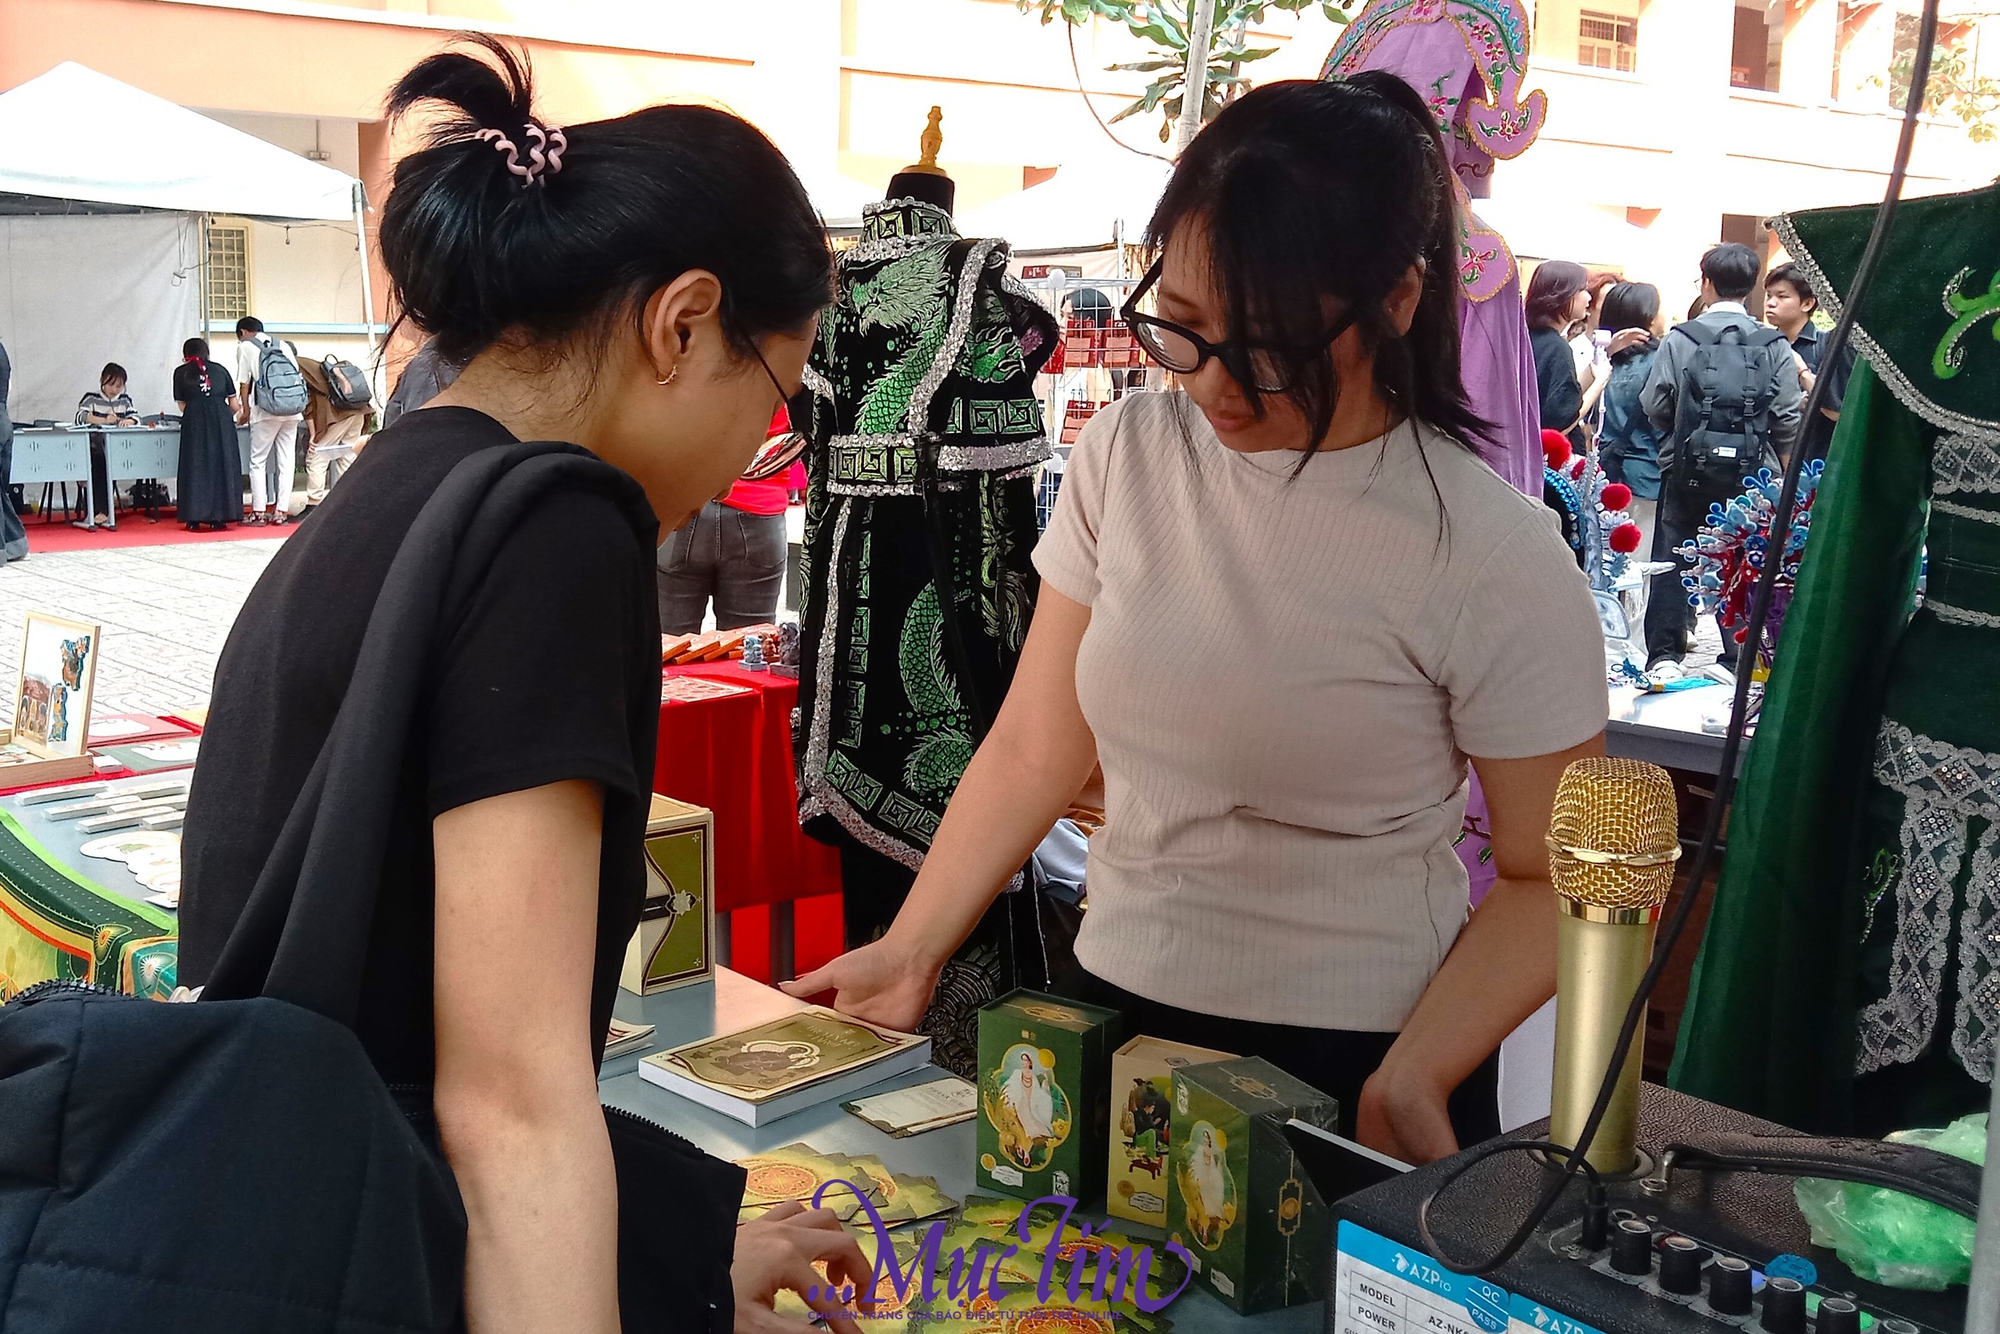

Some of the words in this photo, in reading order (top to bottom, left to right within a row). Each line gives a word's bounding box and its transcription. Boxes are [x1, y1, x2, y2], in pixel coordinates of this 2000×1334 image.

[1409, 1263, 1452, 1292] AZPro
[1359, 1283, 1396, 1307] MODEL
[1481, 1285, 1500, 1303] QC
[1358, 1306, 1396, 1331] POWER
[1471, 1308, 1497, 1330] PASS
